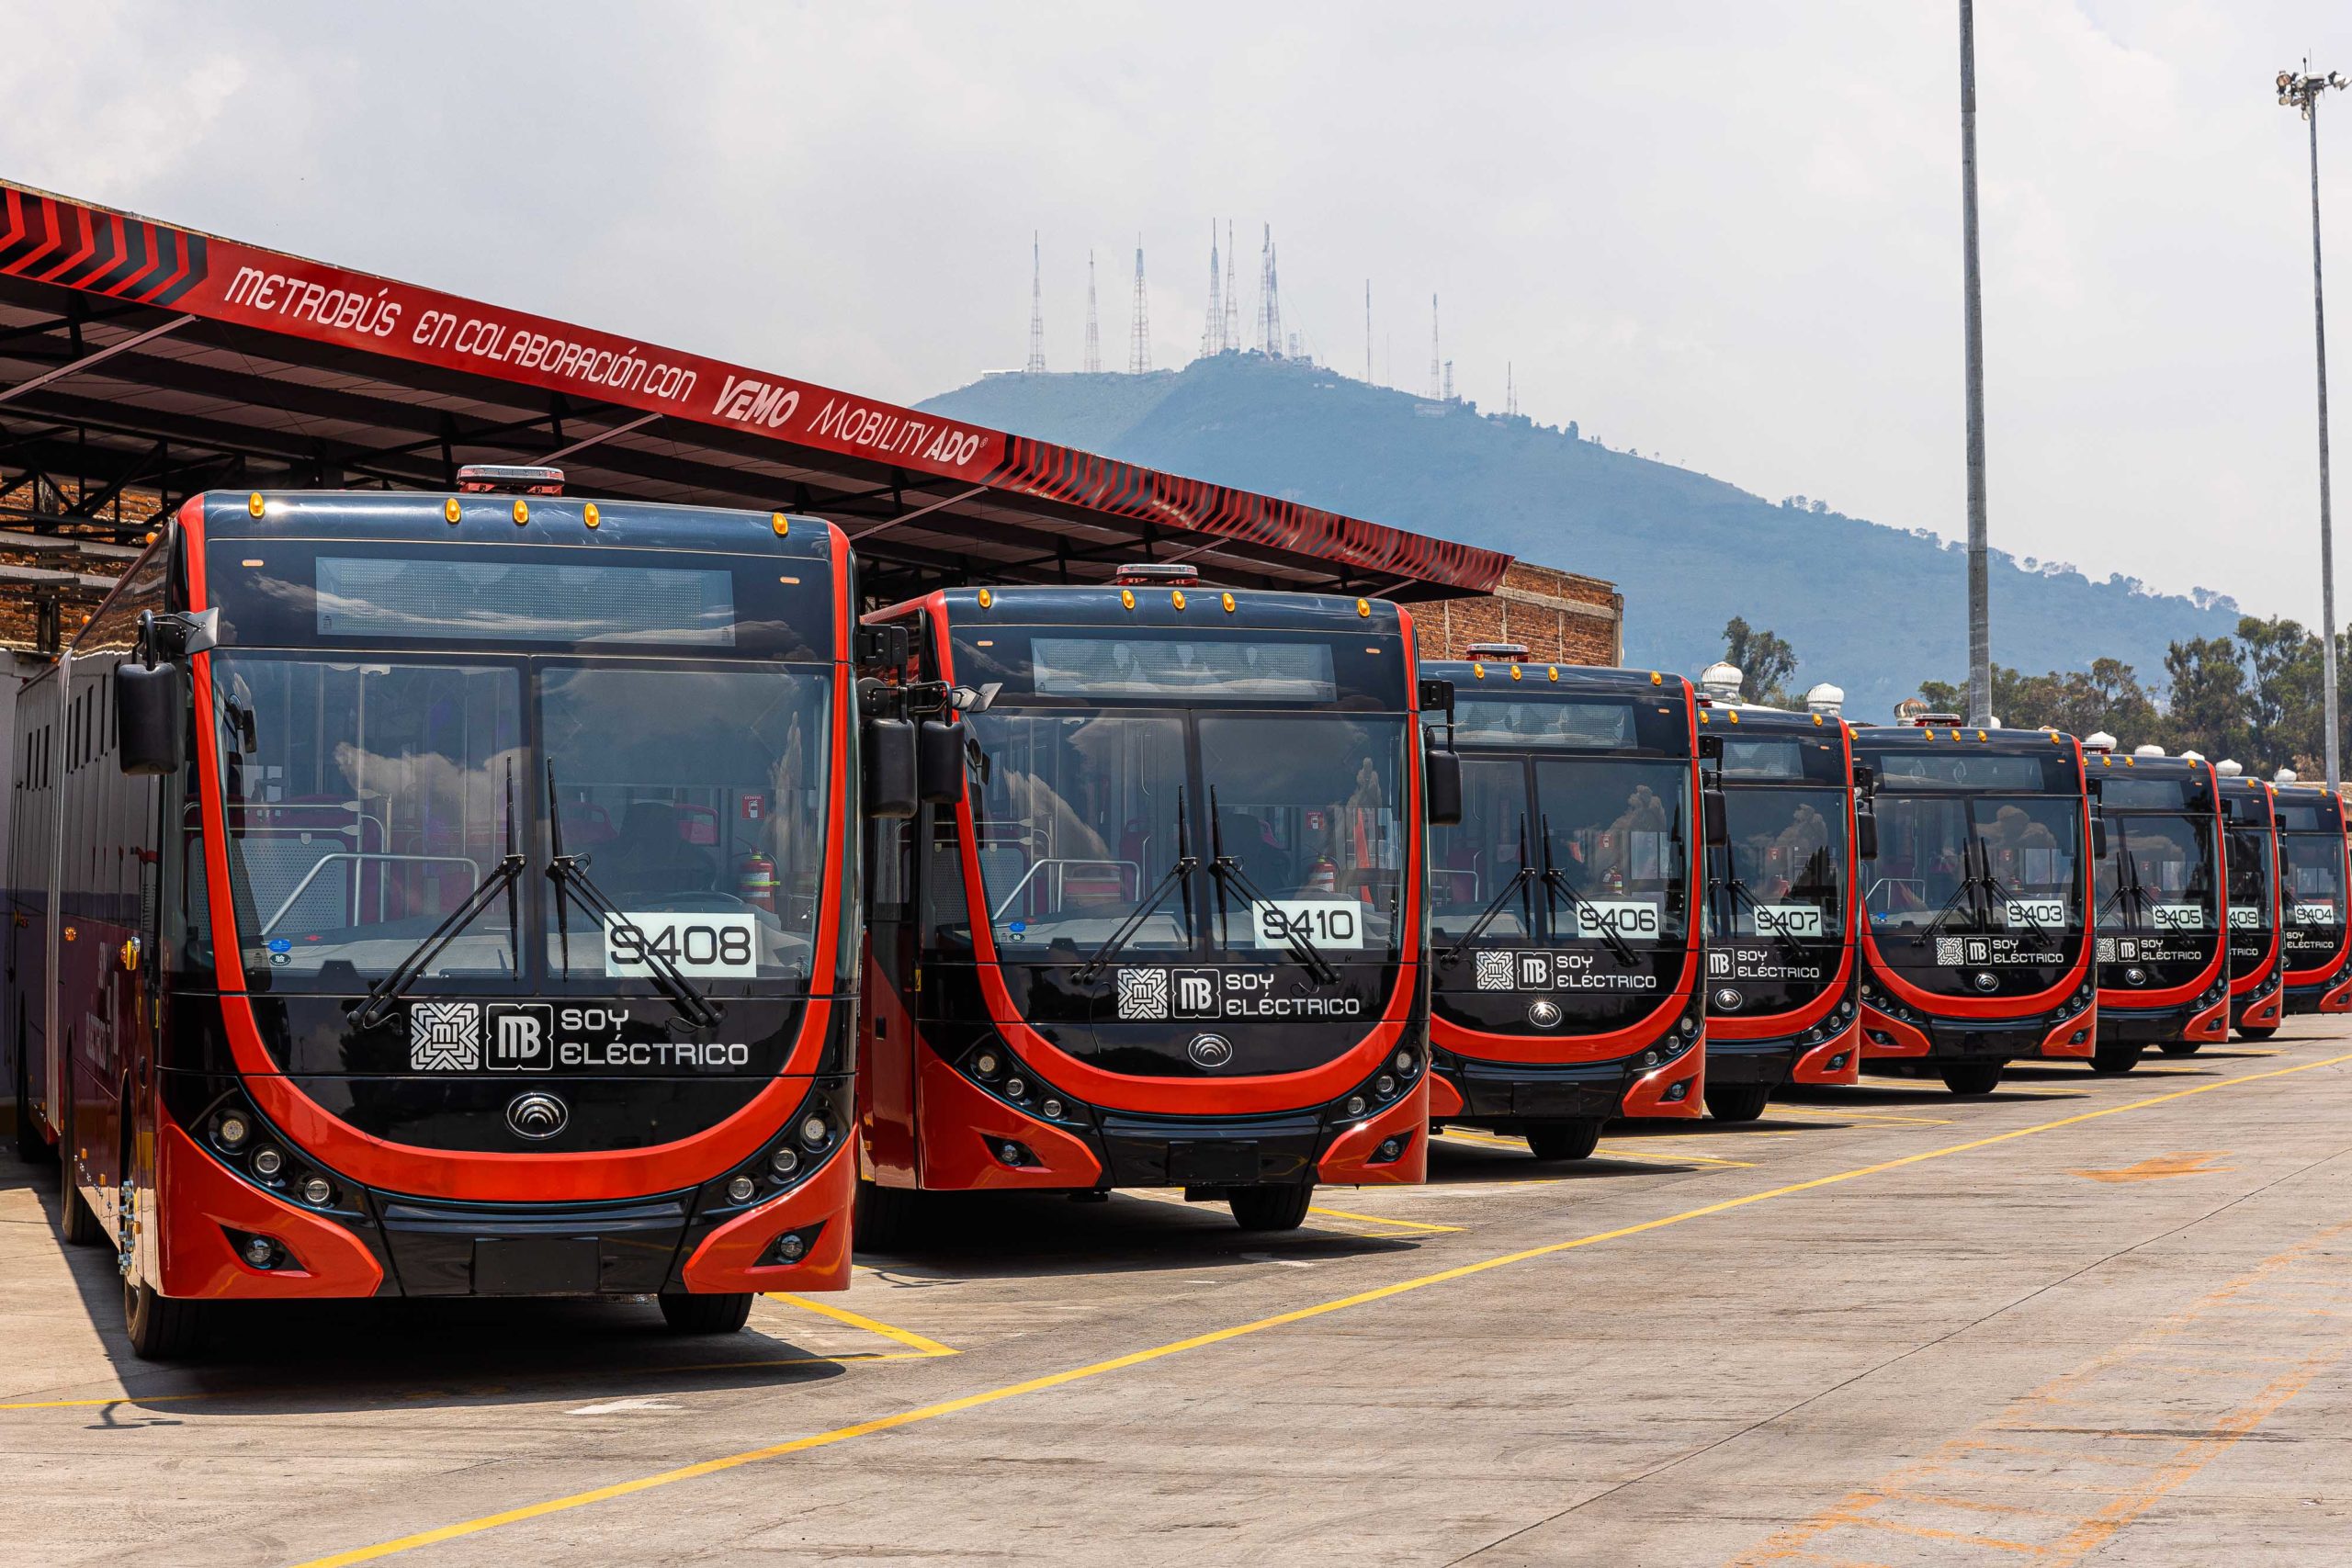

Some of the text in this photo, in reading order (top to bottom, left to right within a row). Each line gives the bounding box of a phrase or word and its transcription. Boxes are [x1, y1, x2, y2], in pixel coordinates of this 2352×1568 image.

[224, 266, 401, 337] METROBÚS
[413, 310, 457, 348] EN
[455, 319, 647, 390] COLABORACIÓN
[643, 364, 696, 402] CON
[712, 375, 799, 428] VEMO
[1969, 942, 1986, 960] MB
[1993, 940, 2018, 950] SOY
[2120, 942, 2135, 958] MB
[2141, 939, 2163, 948] SOY
[1556, 955, 1593, 969] SOY
[1737, 951, 1768, 962] SOY
[1994, 950, 2064, 964] ELÉCTRICO
[2141, 948, 2201, 960] ELÉCTRICO
[1522, 959, 1546, 983] MB
[1710, 953, 1729, 974] MB
[1737, 963, 1819, 978] ELÉCTRICO
[1226, 974, 1274, 990] SOY
[1556, 969, 1657, 988] ELÉCTRICO
[1181, 977, 1212, 1010] MB
[1226, 992, 1360, 1015] ELÉCTRICO
[560, 1009, 628, 1031] SOY
[498, 1016, 541, 1058] MB
[560, 1034, 749, 1066] ELÉCTRICO
